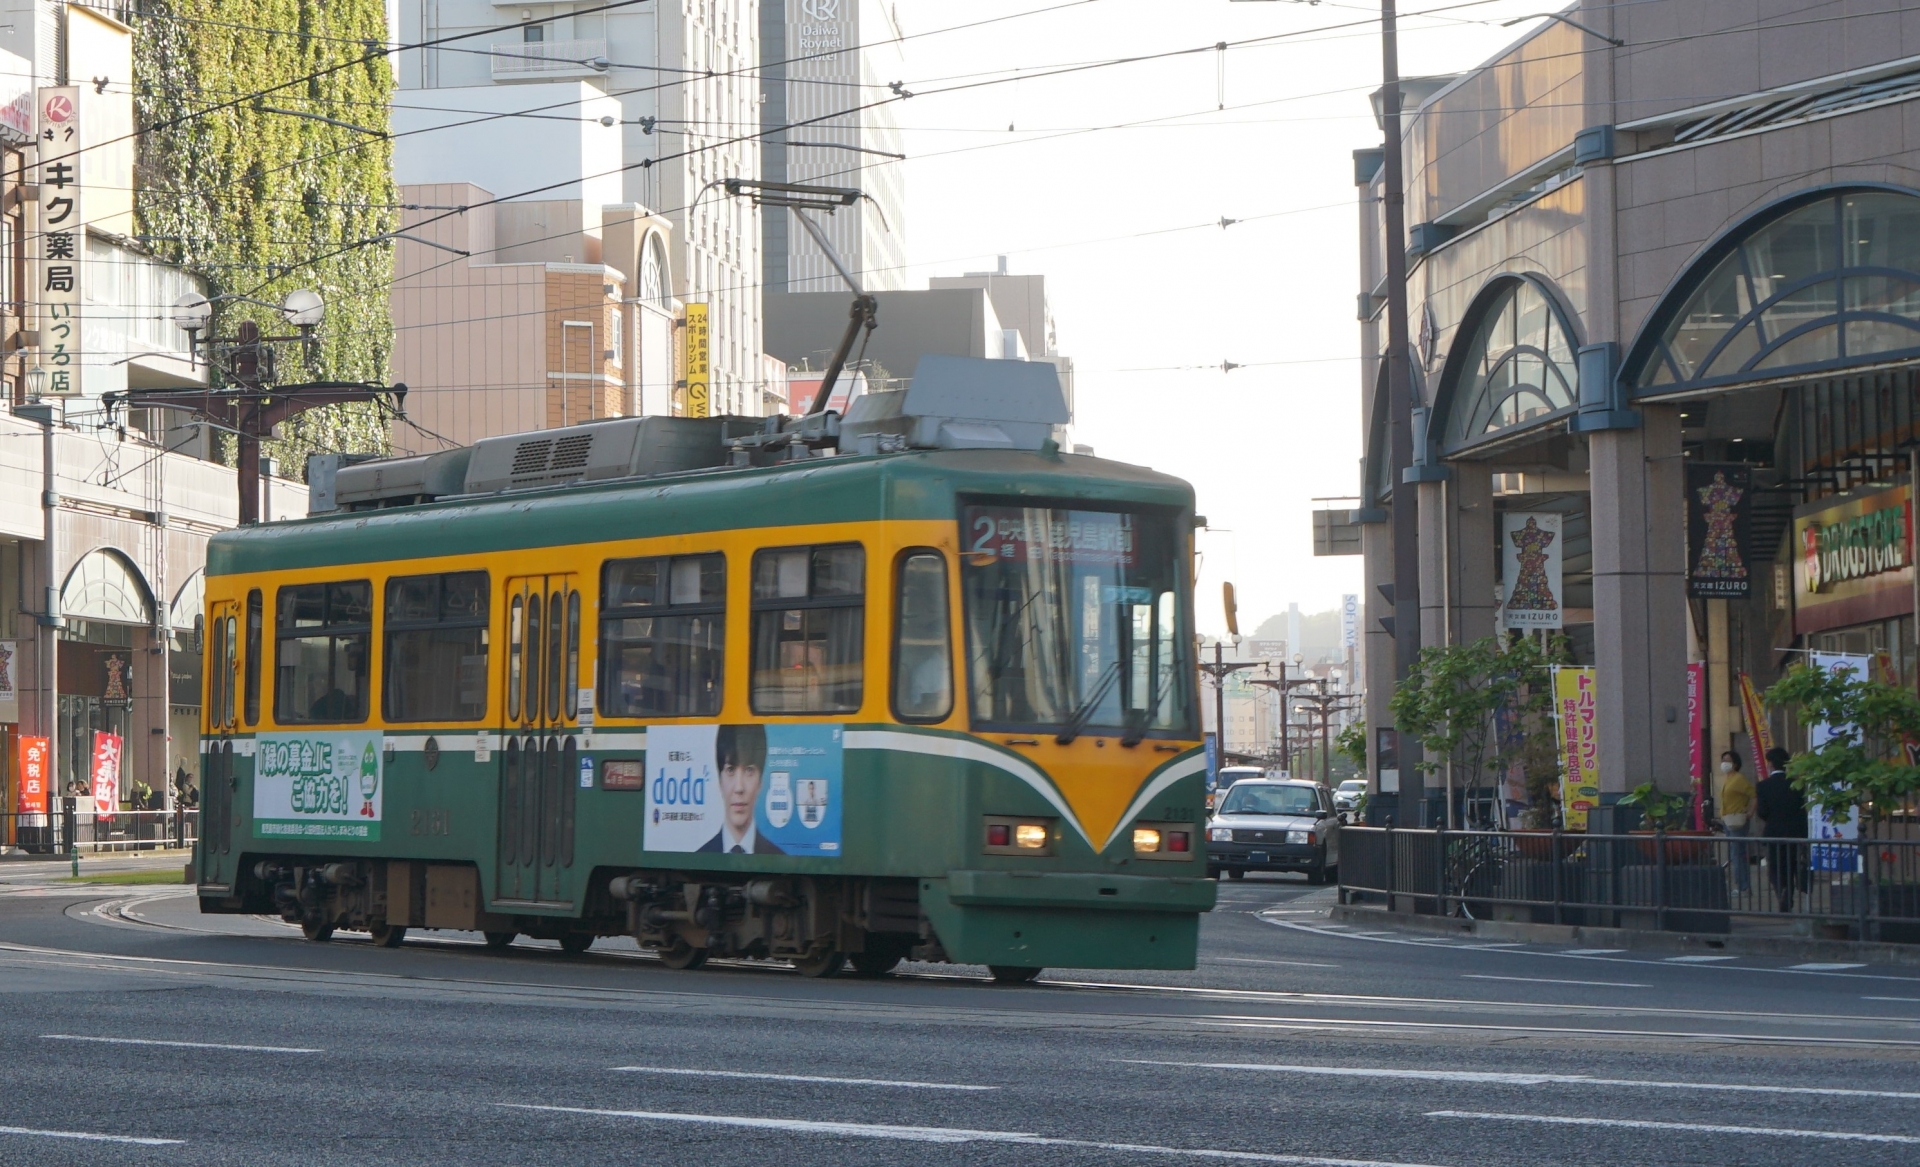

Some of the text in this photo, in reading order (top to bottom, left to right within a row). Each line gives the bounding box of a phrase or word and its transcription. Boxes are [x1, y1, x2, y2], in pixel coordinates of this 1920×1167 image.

[800, 38, 841, 50] Roynet
[803, 25, 838, 36] Daiwa
[805, 51, 837, 61] Hotel
[45, 162, 74, 392] キク薬局 いづろ店
[688, 314, 697, 375] スポーツジム
[697, 313, 707, 374] 24時間営業
[972, 515, 996, 556] 2
[1822, 505, 1902, 583] DRUGSTORE
[1715, 581, 1748, 590] IZURO
[1528, 612, 1558, 621] IZURO
[1563, 698, 1582, 783] 特許健康良品
[1578, 674, 1597, 770] トルマリンの
[26, 746, 41, 794] 免税店
[259, 740, 332, 776] 「緑の募金」に
[653, 766, 705, 806] doda
[410, 809, 450, 836] 2131
